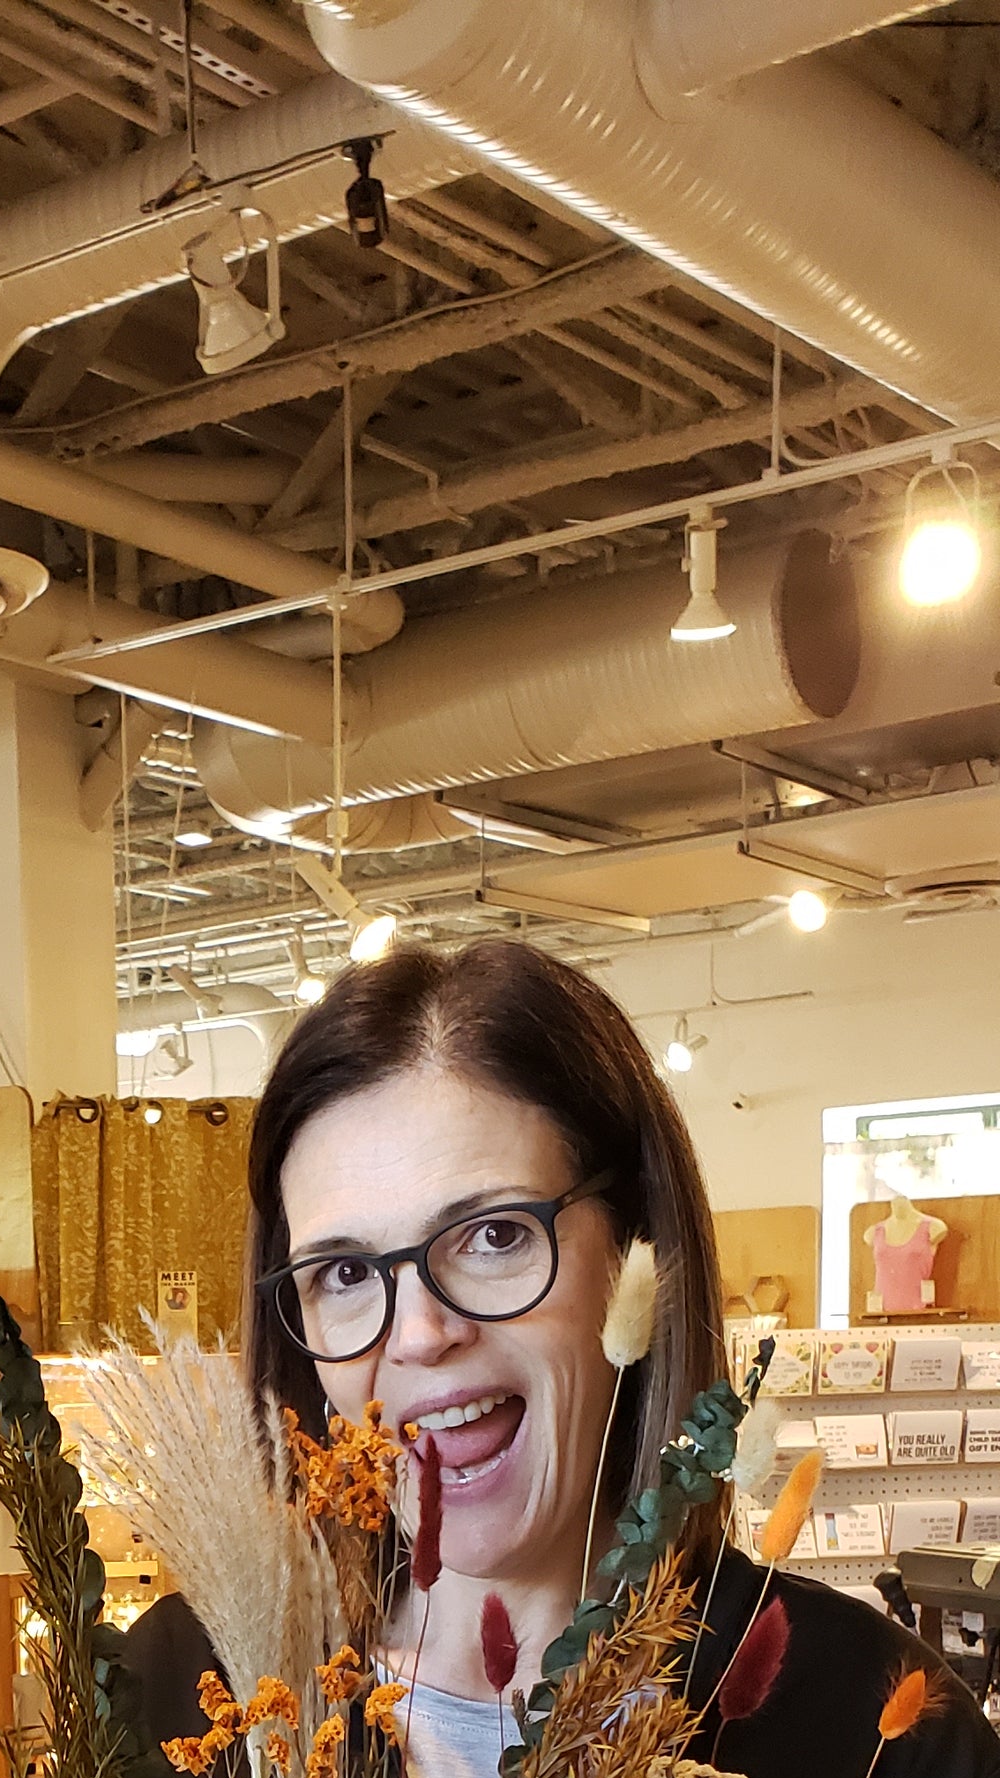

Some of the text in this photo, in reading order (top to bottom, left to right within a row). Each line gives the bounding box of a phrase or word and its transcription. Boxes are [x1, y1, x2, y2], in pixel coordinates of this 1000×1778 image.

[161, 1272, 195, 1281] MEET
[899, 1434, 946, 1445] YOU REALLY
[897, 1445, 956, 1458] ARE QUITE OLD
